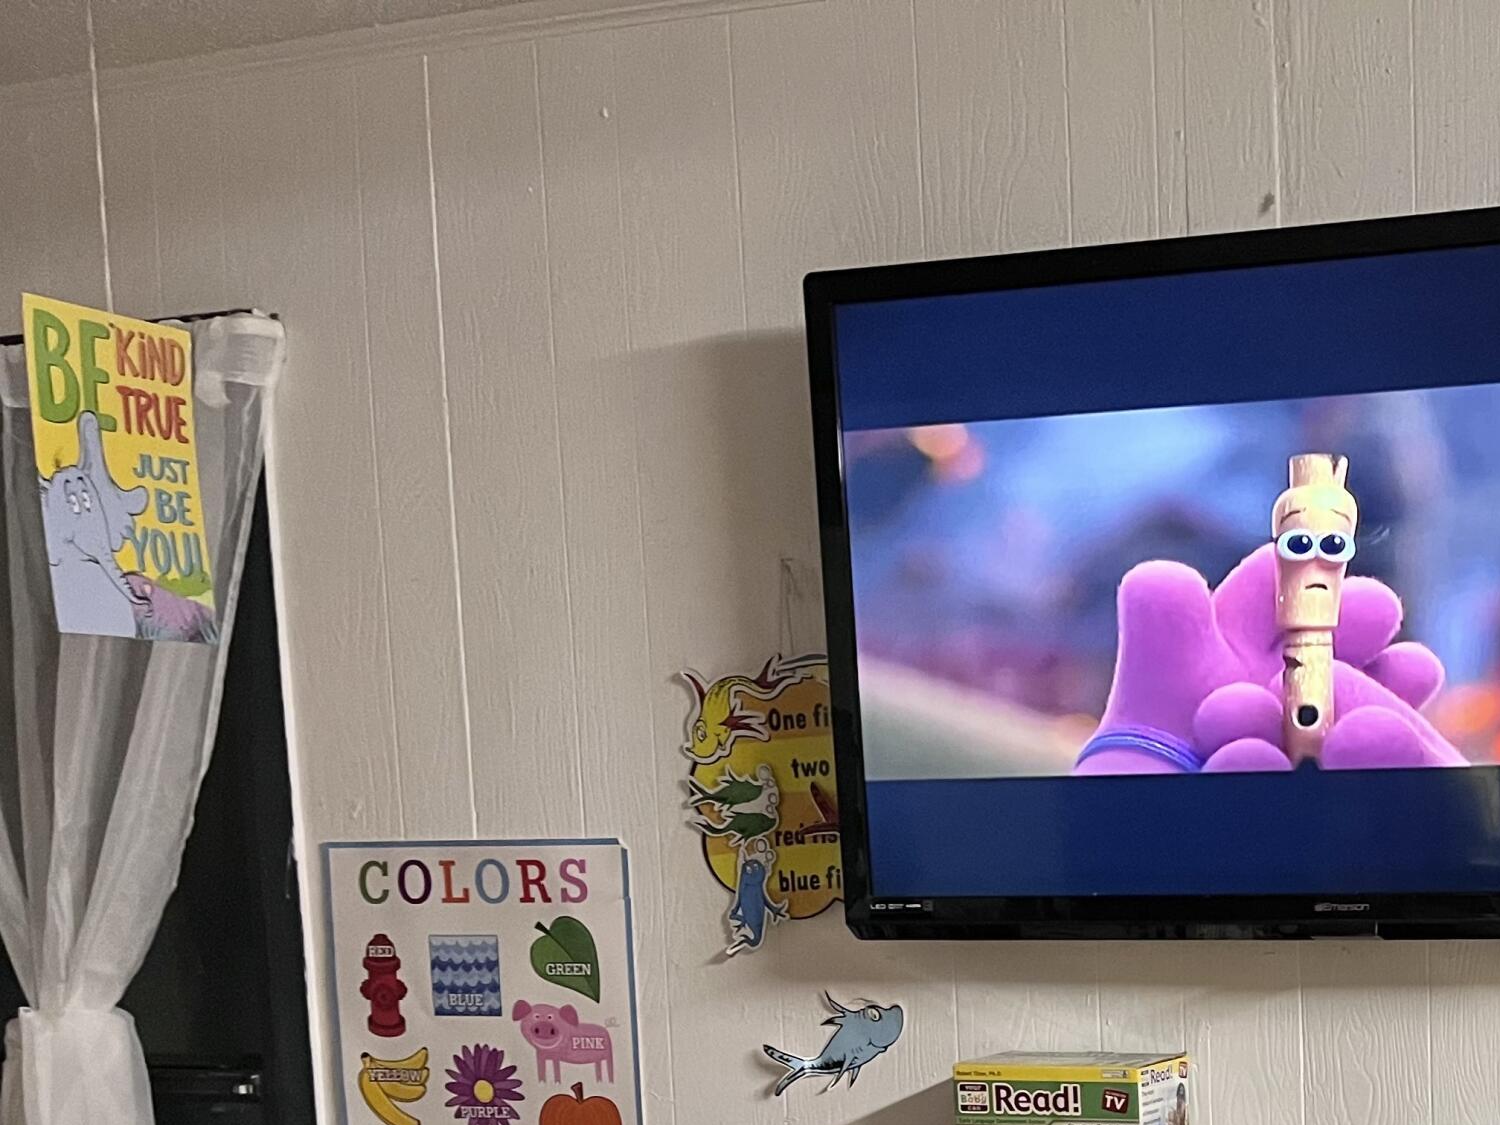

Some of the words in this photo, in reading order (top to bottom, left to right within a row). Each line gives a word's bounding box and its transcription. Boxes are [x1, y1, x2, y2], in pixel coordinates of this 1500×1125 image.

[33, 308, 117, 432] BE
[116, 386, 190, 443] TRUE
[133, 453, 190, 485] JUST
[155, 491, 194, 526] BE
[128, 525, 205, 577] YOU!
[768, 708, 806, 732] One
[791, 758, 829, 778] two
[359, 858, 589, 905] COLORS
[778, 869, 820, 893] blue
[369, 945, 395, 958] RED
[545, 963, 592, 977] GREEN
[448, 992, 484, 1008] BLUE
[571, 1036, 606, 1050] PINK
[369, 1069, 424, 1083] YELLOW
[1150, 1064, 1173, 1084] Read!
[994, 1084, 1079, 1113] Read!
[1105, 1095, 1126, 1110] TV
[460, 1106, 511, 1119] PURPLE
